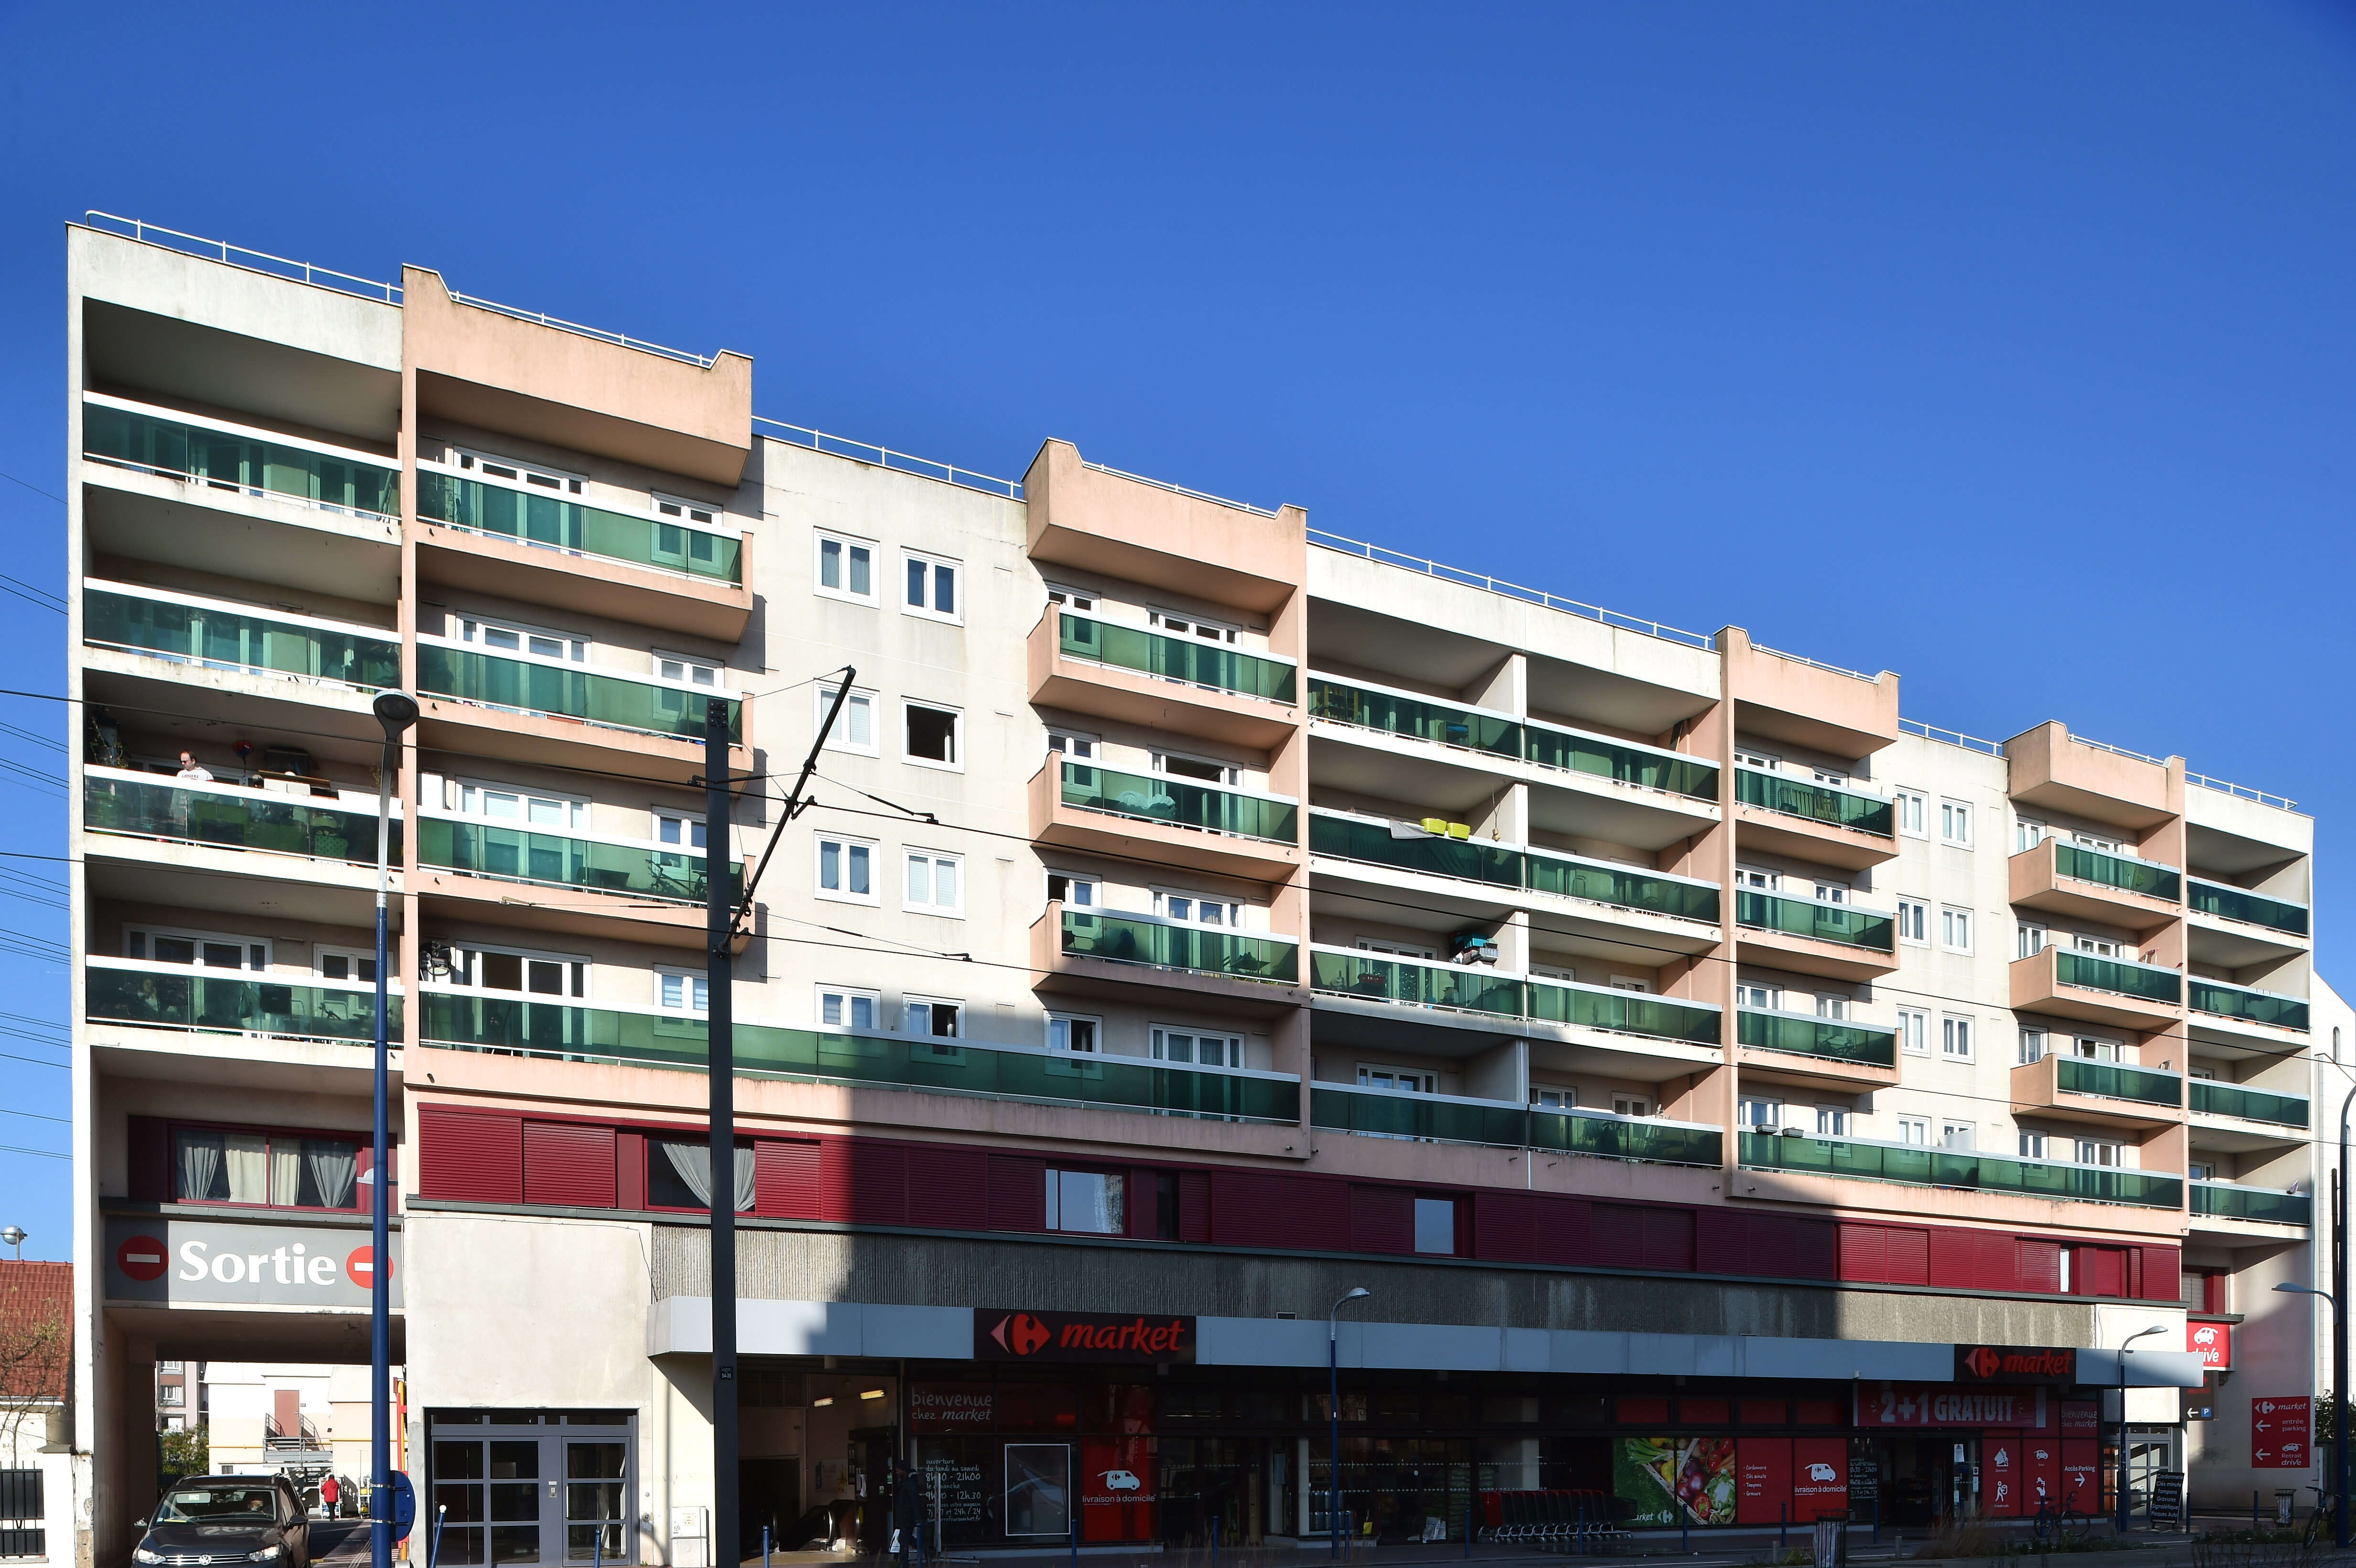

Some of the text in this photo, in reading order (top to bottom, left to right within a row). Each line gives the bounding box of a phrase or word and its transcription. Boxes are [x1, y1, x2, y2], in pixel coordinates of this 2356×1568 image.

[179, 1240, 337, 1285] Sortie
[1059, 1318, 1185, 1355] market
[2003, 1350, 2072, 1376] market
[912, 1385, 992, 1406] bienvenue
[1881, 1391, 2014, 1424] 2+1 GRATUIT
[2062, 1408, 2097, 1419] bienvenue
[912, 1408, 992, 1421] chez market
[2075, 1420, 2097, 1428] market
[926, 1472, 947, 1481] 8h0
[957, 1472, 981, 1481] 21h00
[926, 1491, 947, 1500] 9h0
[957, 1491, 981, 1499] 12h30
[1629, 1513, 1655, 1522] arket
